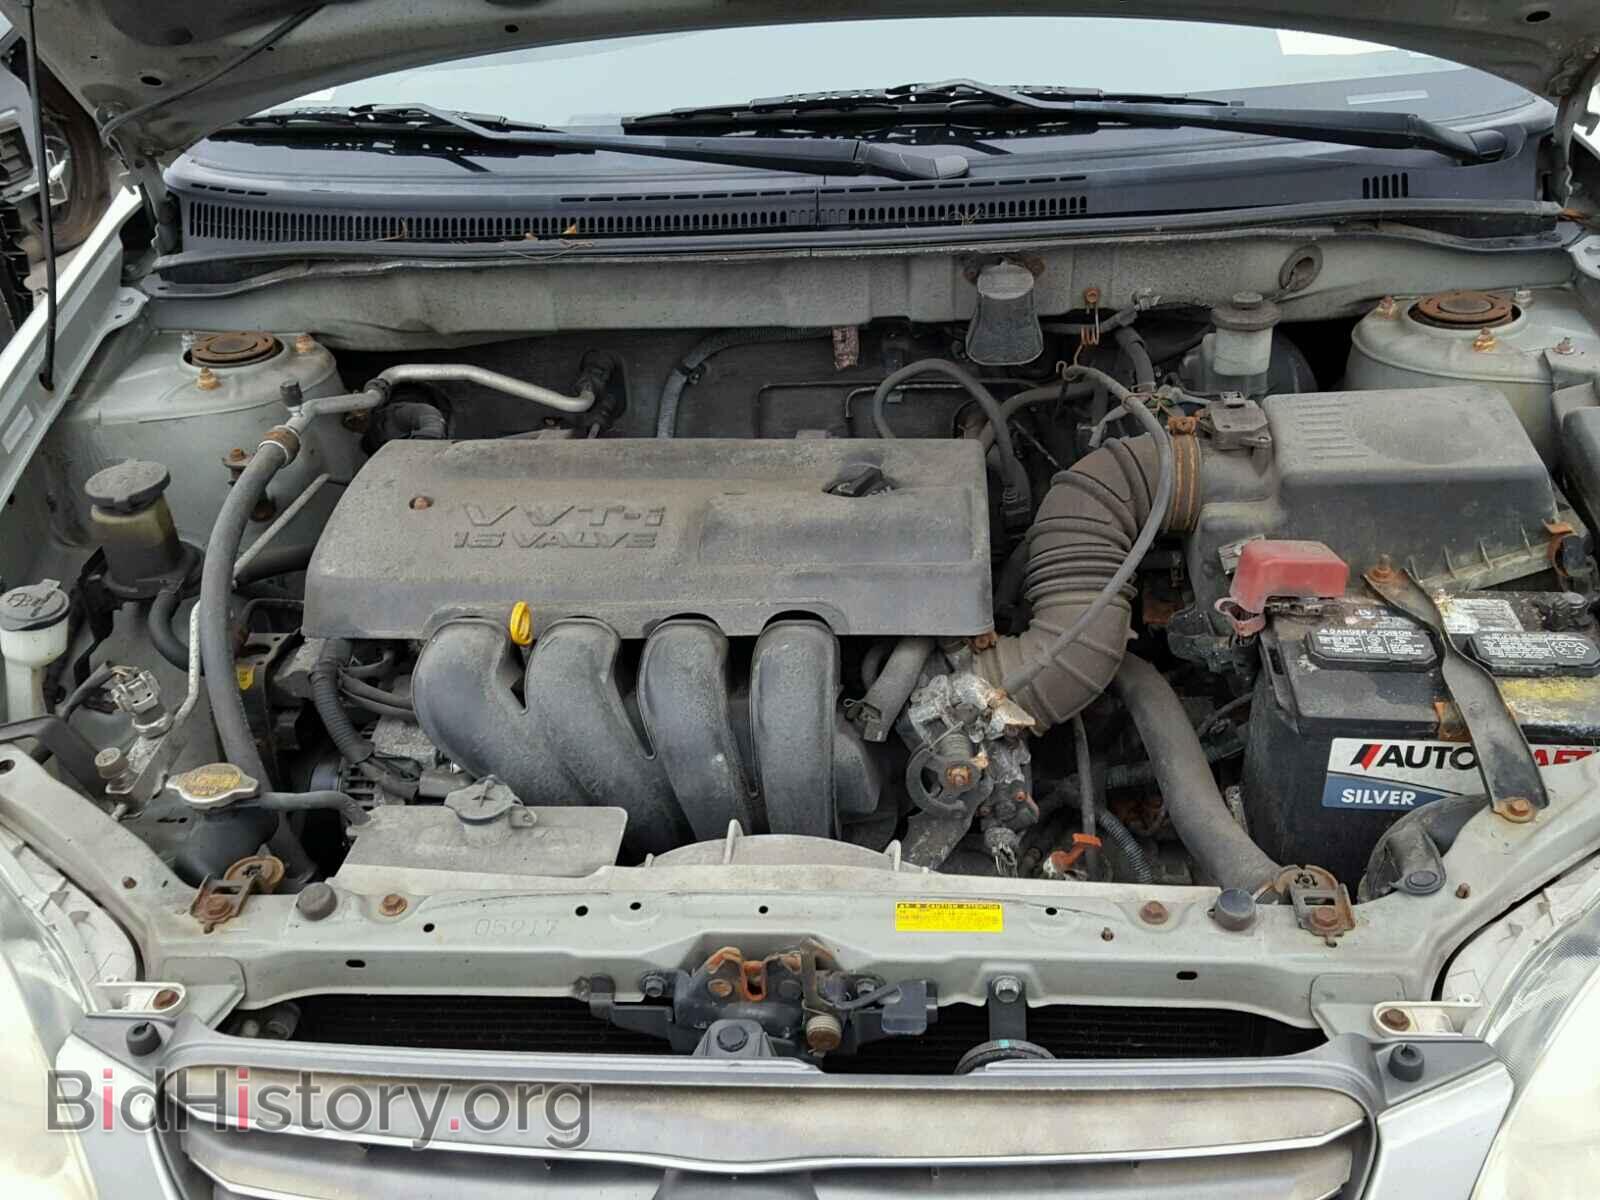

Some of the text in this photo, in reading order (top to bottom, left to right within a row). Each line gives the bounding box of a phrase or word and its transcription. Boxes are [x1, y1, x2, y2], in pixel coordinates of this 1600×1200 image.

[453, 531, 658, 549] 16 VALVE
[1341, 787, 1417, 806] SILVER
